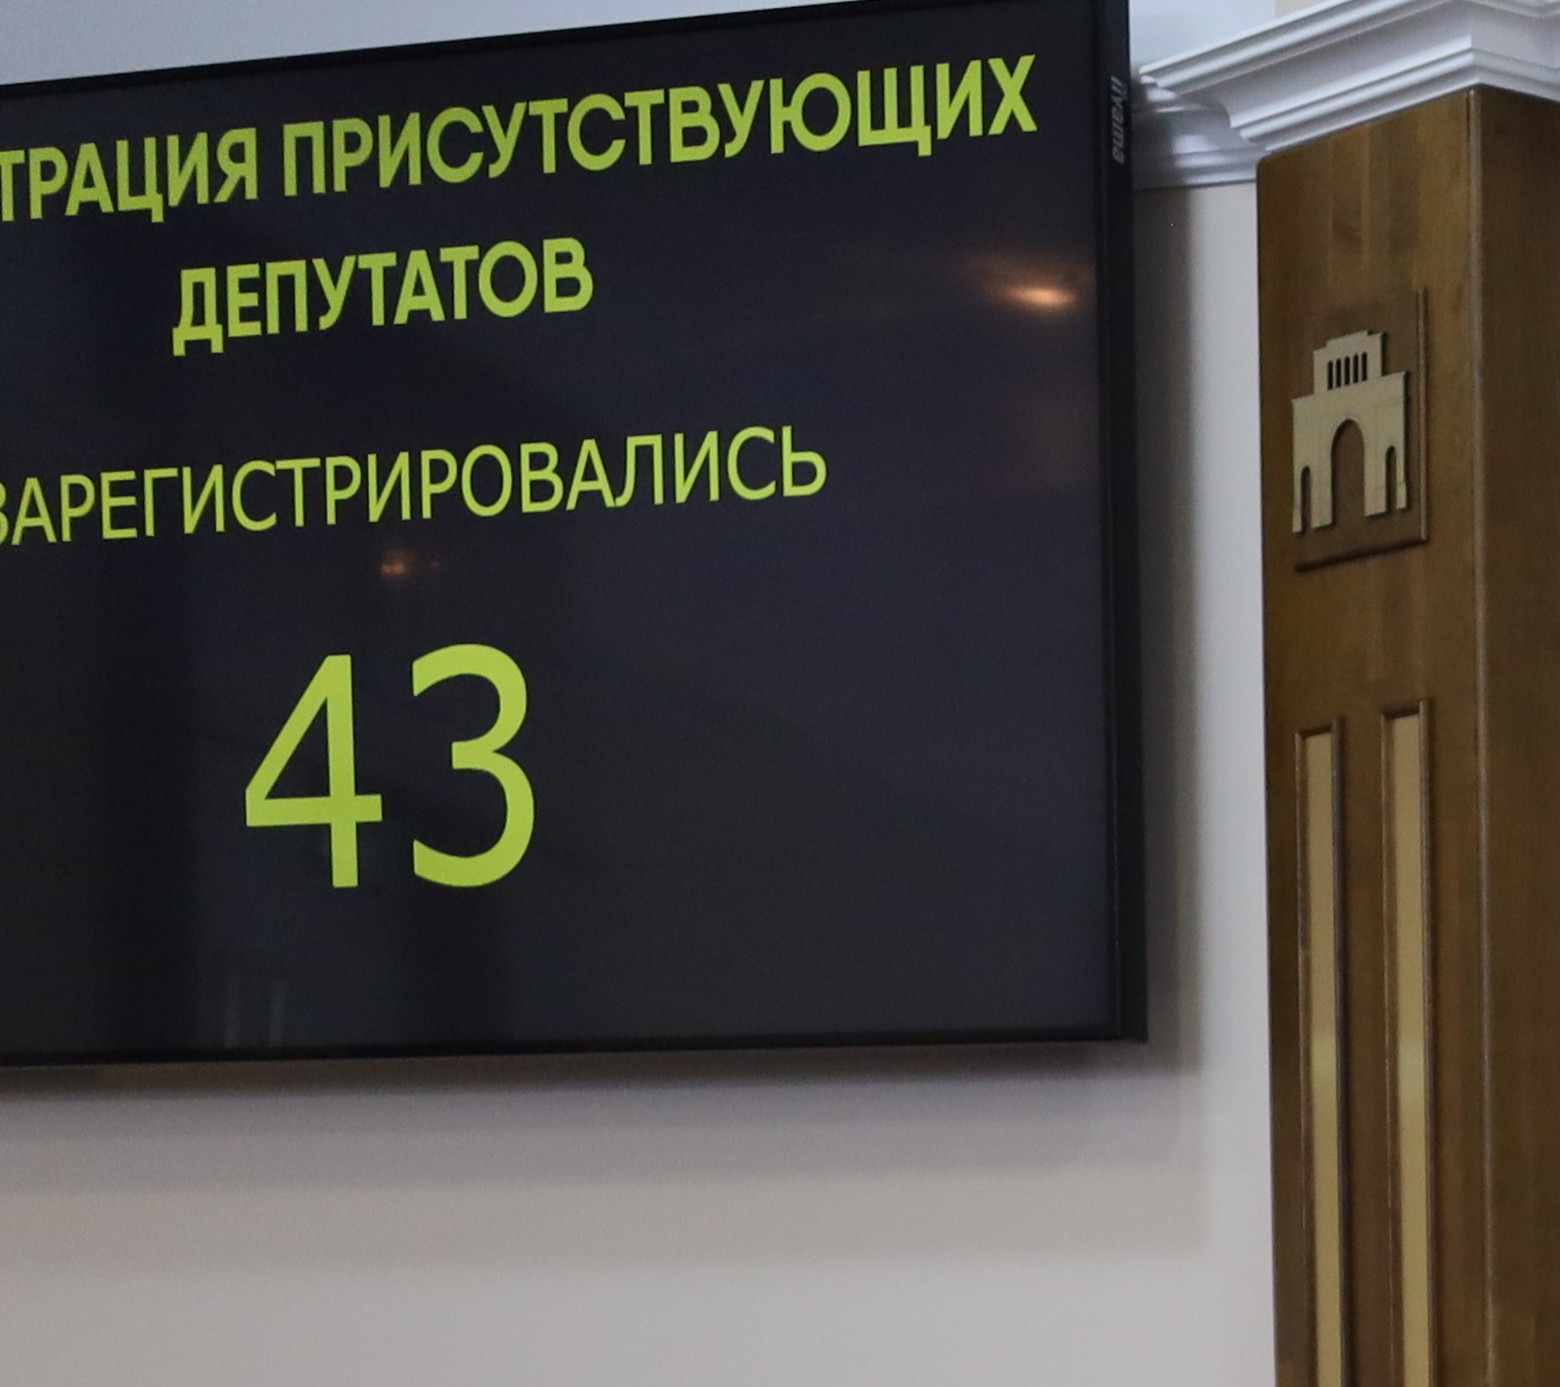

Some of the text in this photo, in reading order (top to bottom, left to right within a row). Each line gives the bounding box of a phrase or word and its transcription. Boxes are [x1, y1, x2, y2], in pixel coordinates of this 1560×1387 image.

[284, 56, 1036, 195] ПРИСУТСТВУЮЩИХ
[173, 238, 593, 355] ДЕПУТАТОВ
[246, 644, 534, 887] 43
